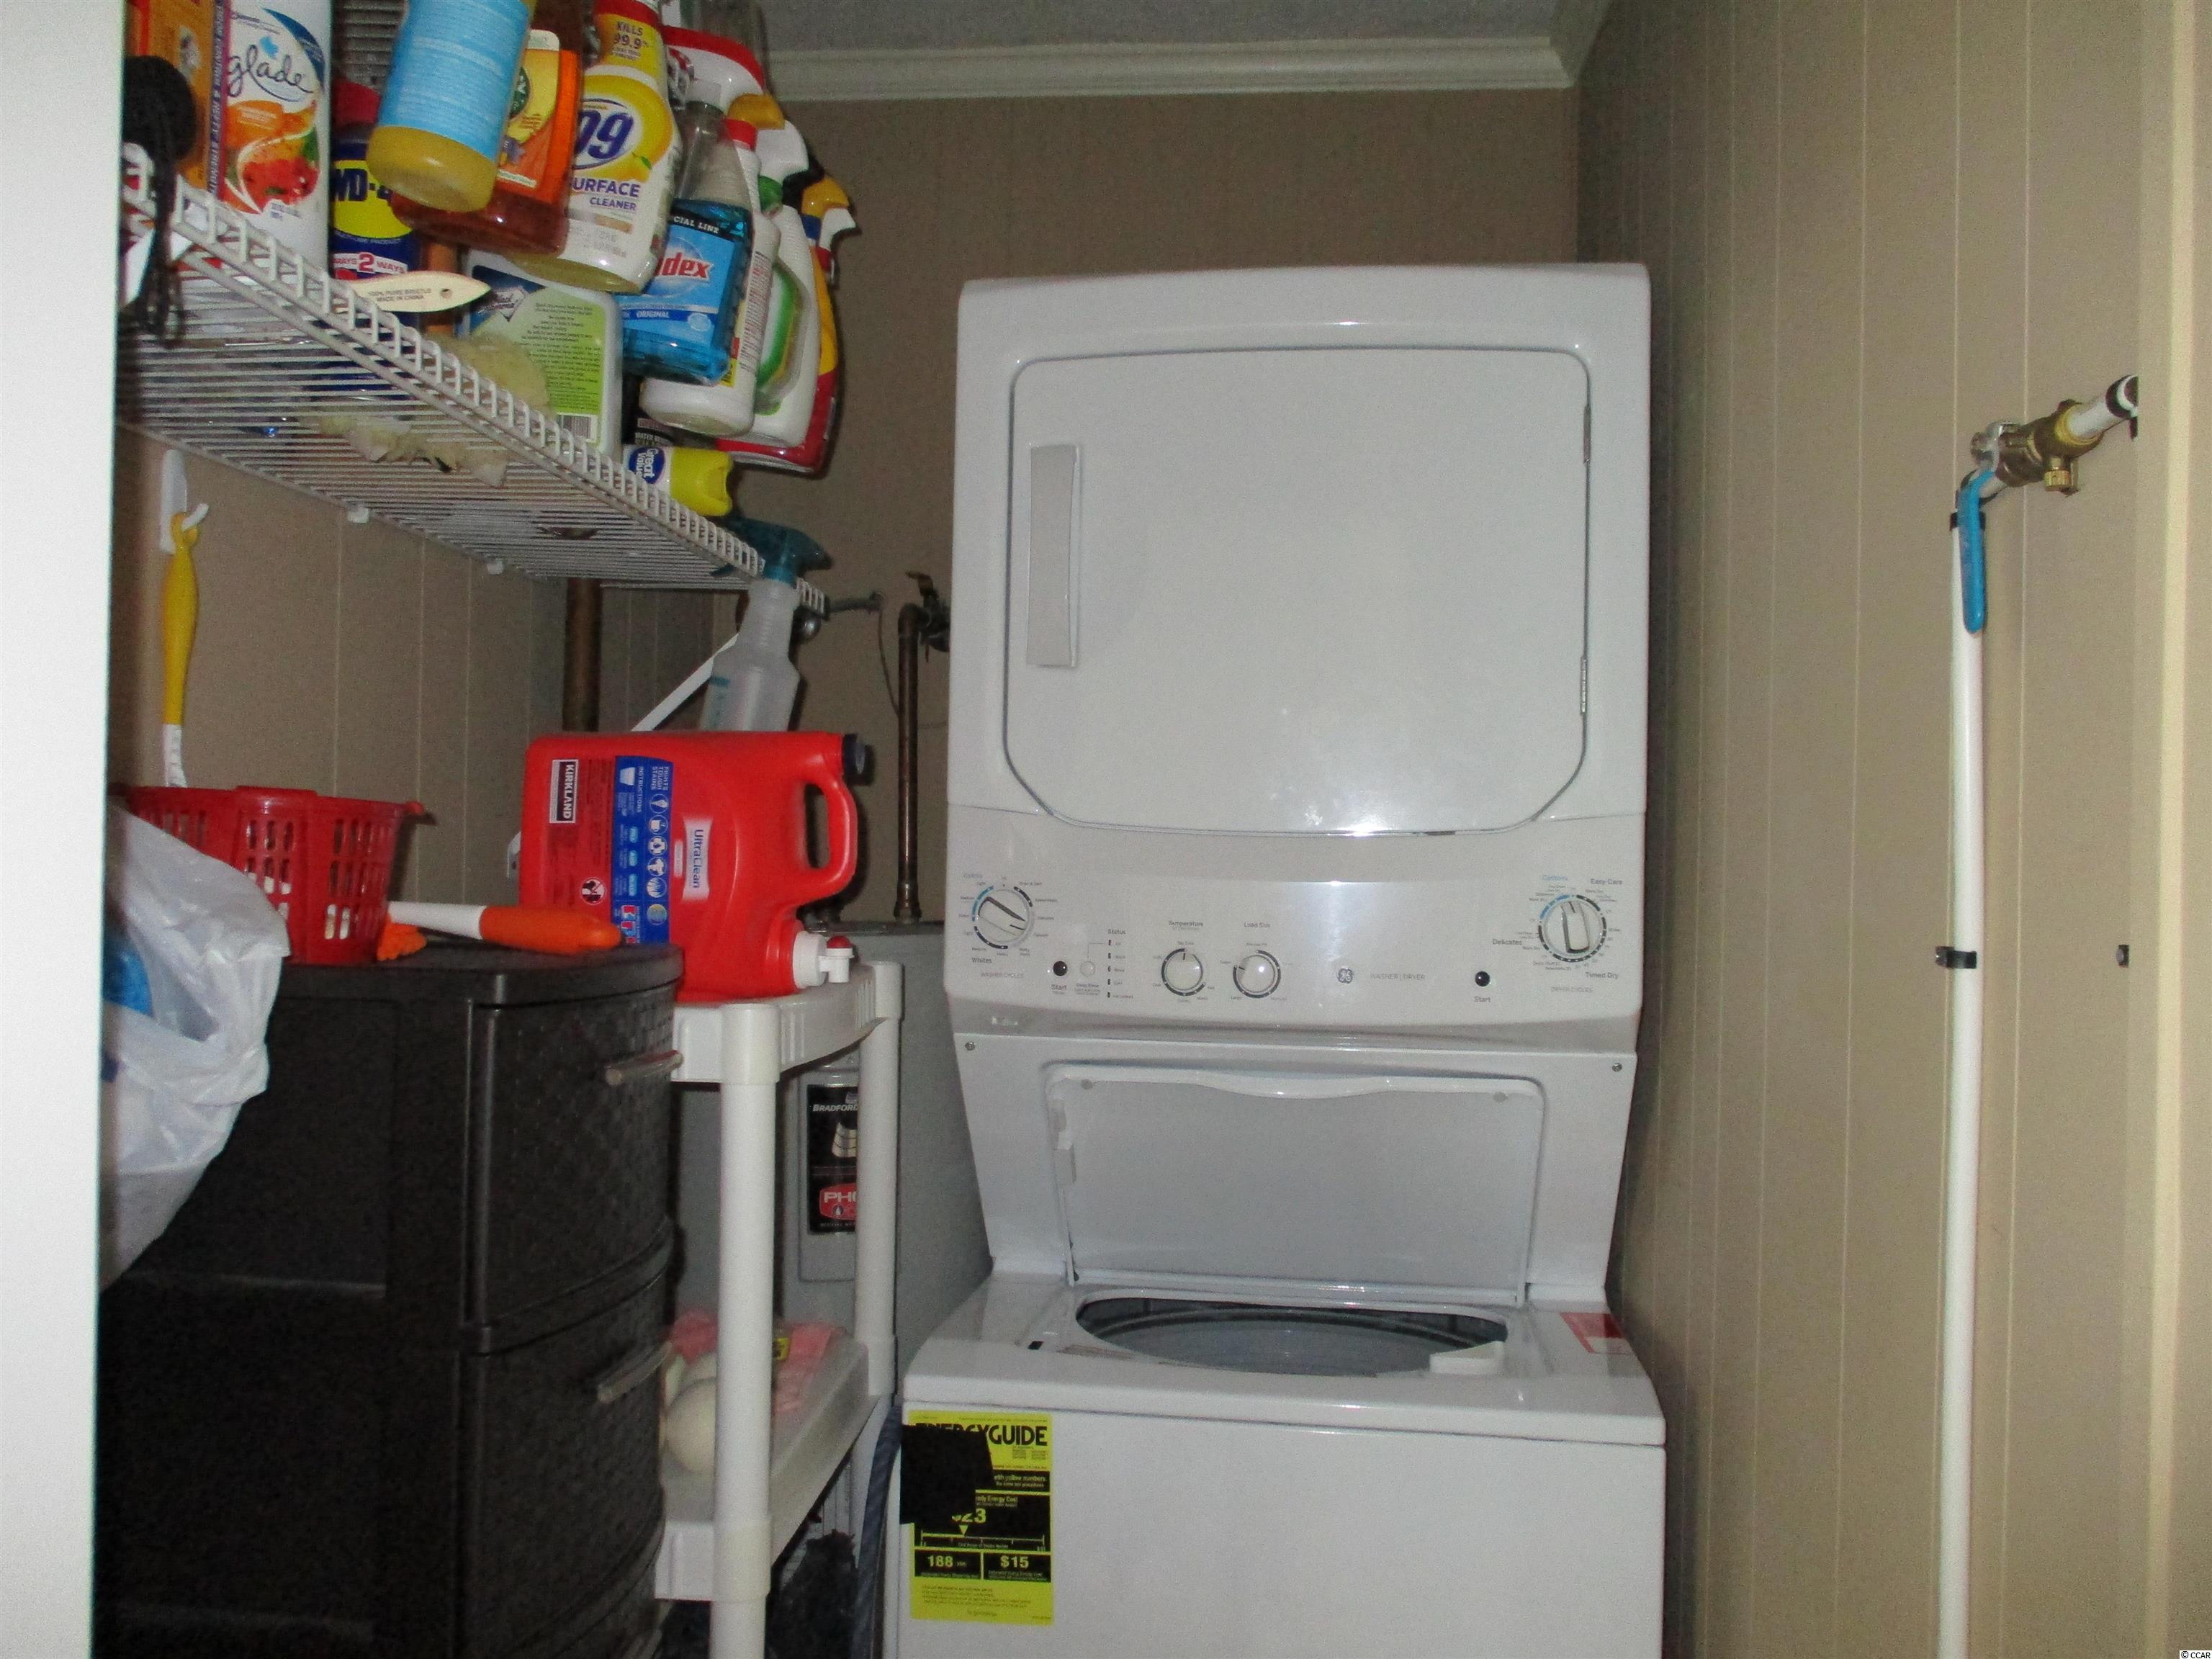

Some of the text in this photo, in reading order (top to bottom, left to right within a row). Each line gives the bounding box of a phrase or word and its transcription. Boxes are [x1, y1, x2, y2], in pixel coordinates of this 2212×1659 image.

[617, 21, 643, 36] KILLS
[227, 45, 314, 98] glade
[575, 109, 634, 160] 09
[572, 177, 641, 198] URFACE
[589, 197, 637, 211] CLEANER
[673, 216, 720, 234] CIAL LINE
[358, 252, 375, 271] 2
[377, 261, 406, 274] WAYS
[655, 252, 711, 279] dex
[636, 453, 647, 478] Value
[644, 448, 659, 478] Great
[562, 764, 575, 819] KIRKLAND
[637, 766, 645, 813] INSTRUCTIONS
[692, 829, 704, 889] UltraClean
[812, 1103, 858, 1112] BRADFORD
[927, 1555, 954, 1568] 188
[999, 1555, 1030, 1569] $15
